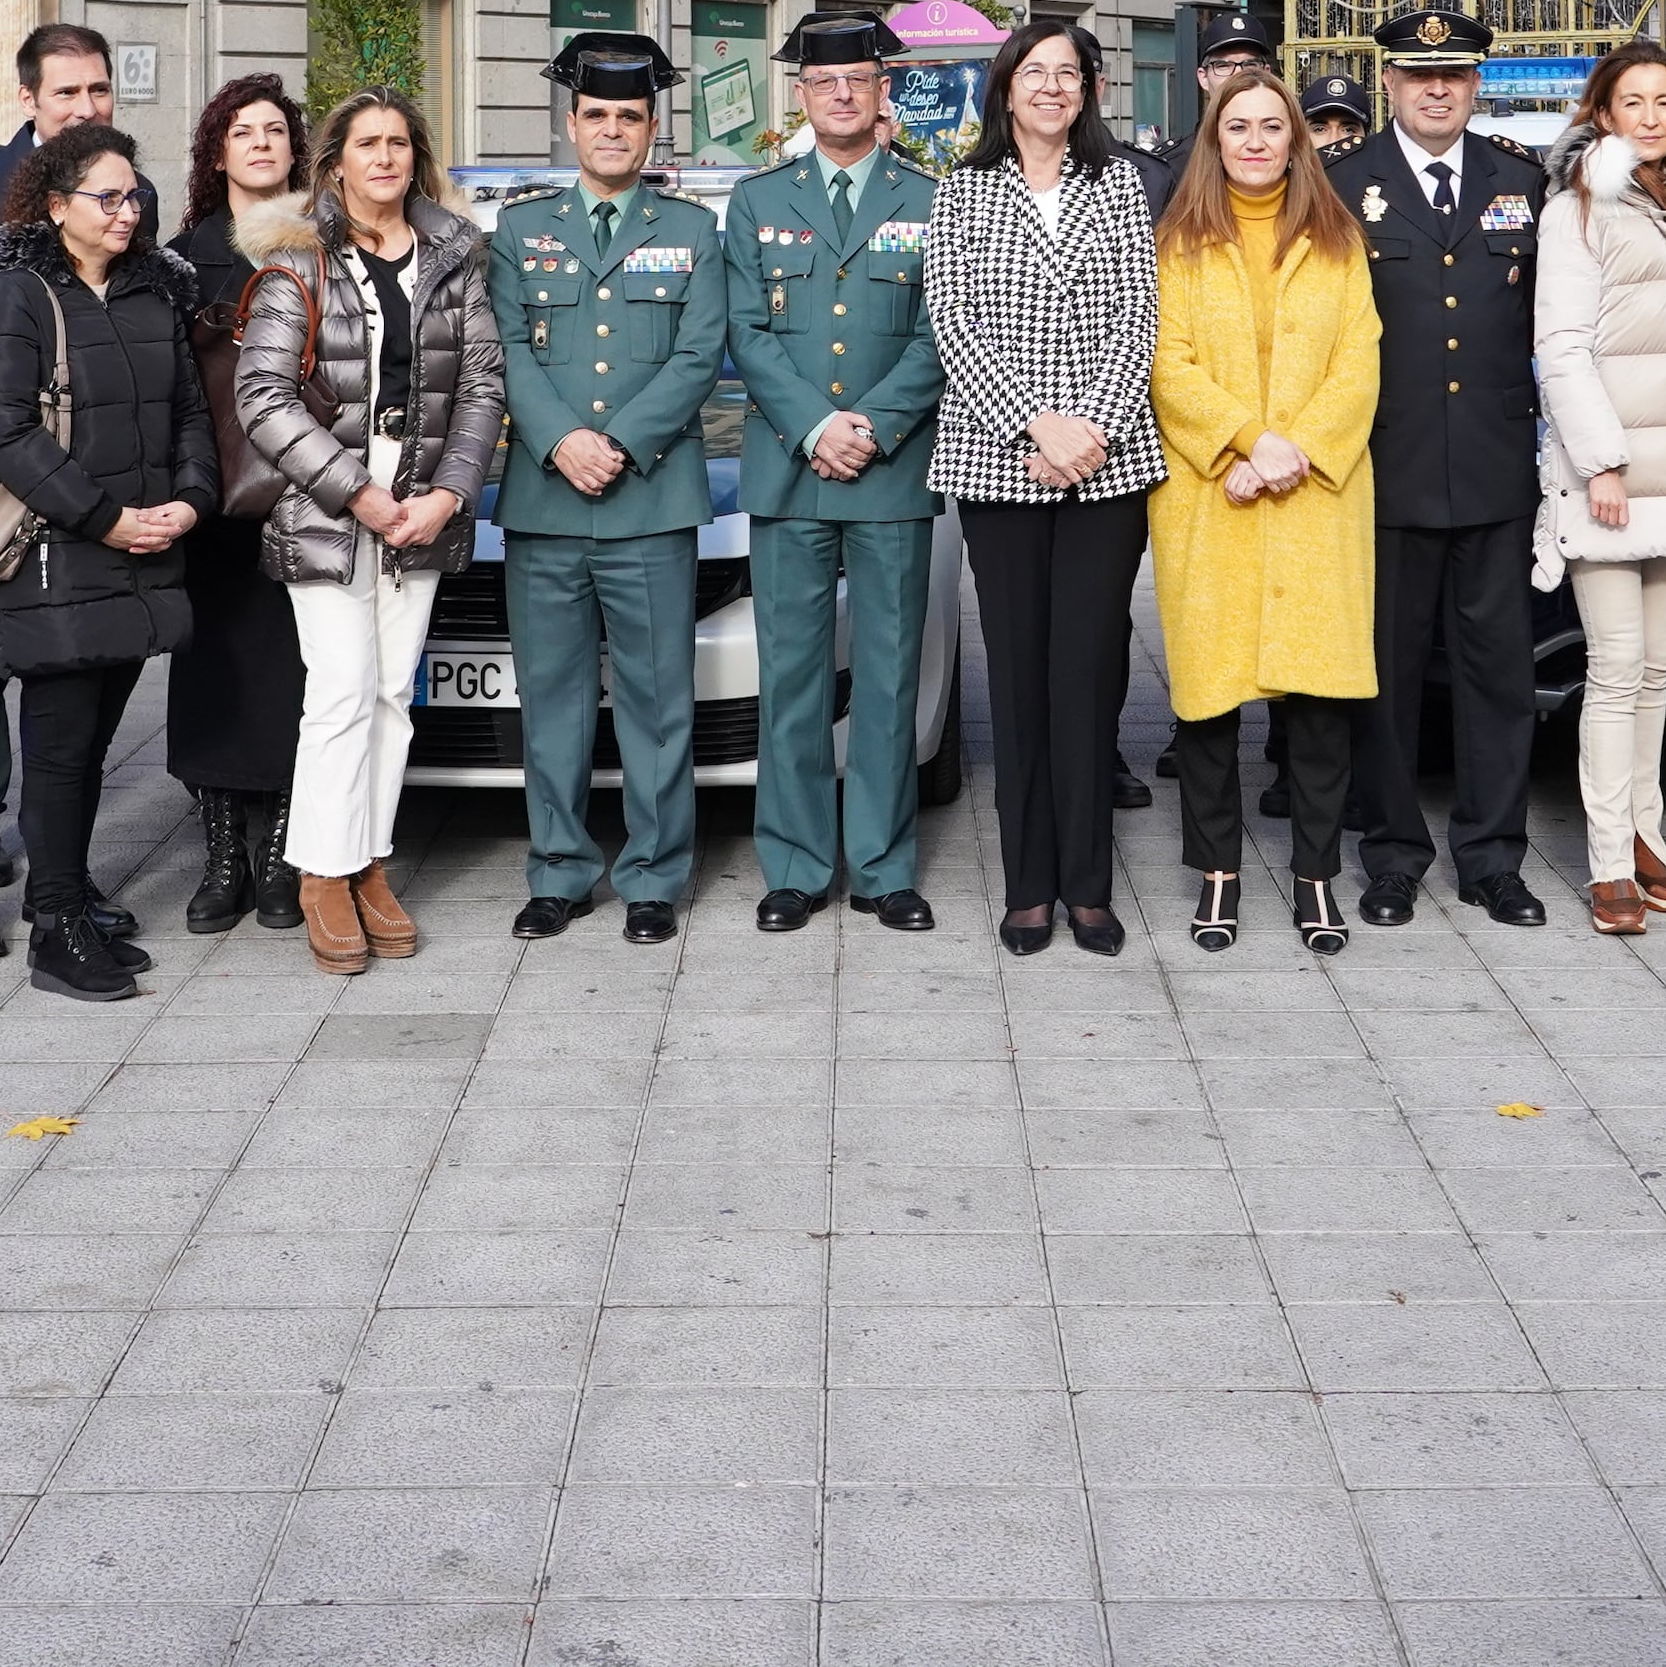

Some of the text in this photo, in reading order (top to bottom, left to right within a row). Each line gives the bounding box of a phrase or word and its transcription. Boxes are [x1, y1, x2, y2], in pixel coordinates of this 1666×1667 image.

[895, 28, 979, 39] información turística
[905, 70, 939, 93] Pide
[909, 90, 939, 106] deseo
[894, 103, 944, 123] Navidad
[432, 661, 502, 700] PGC
